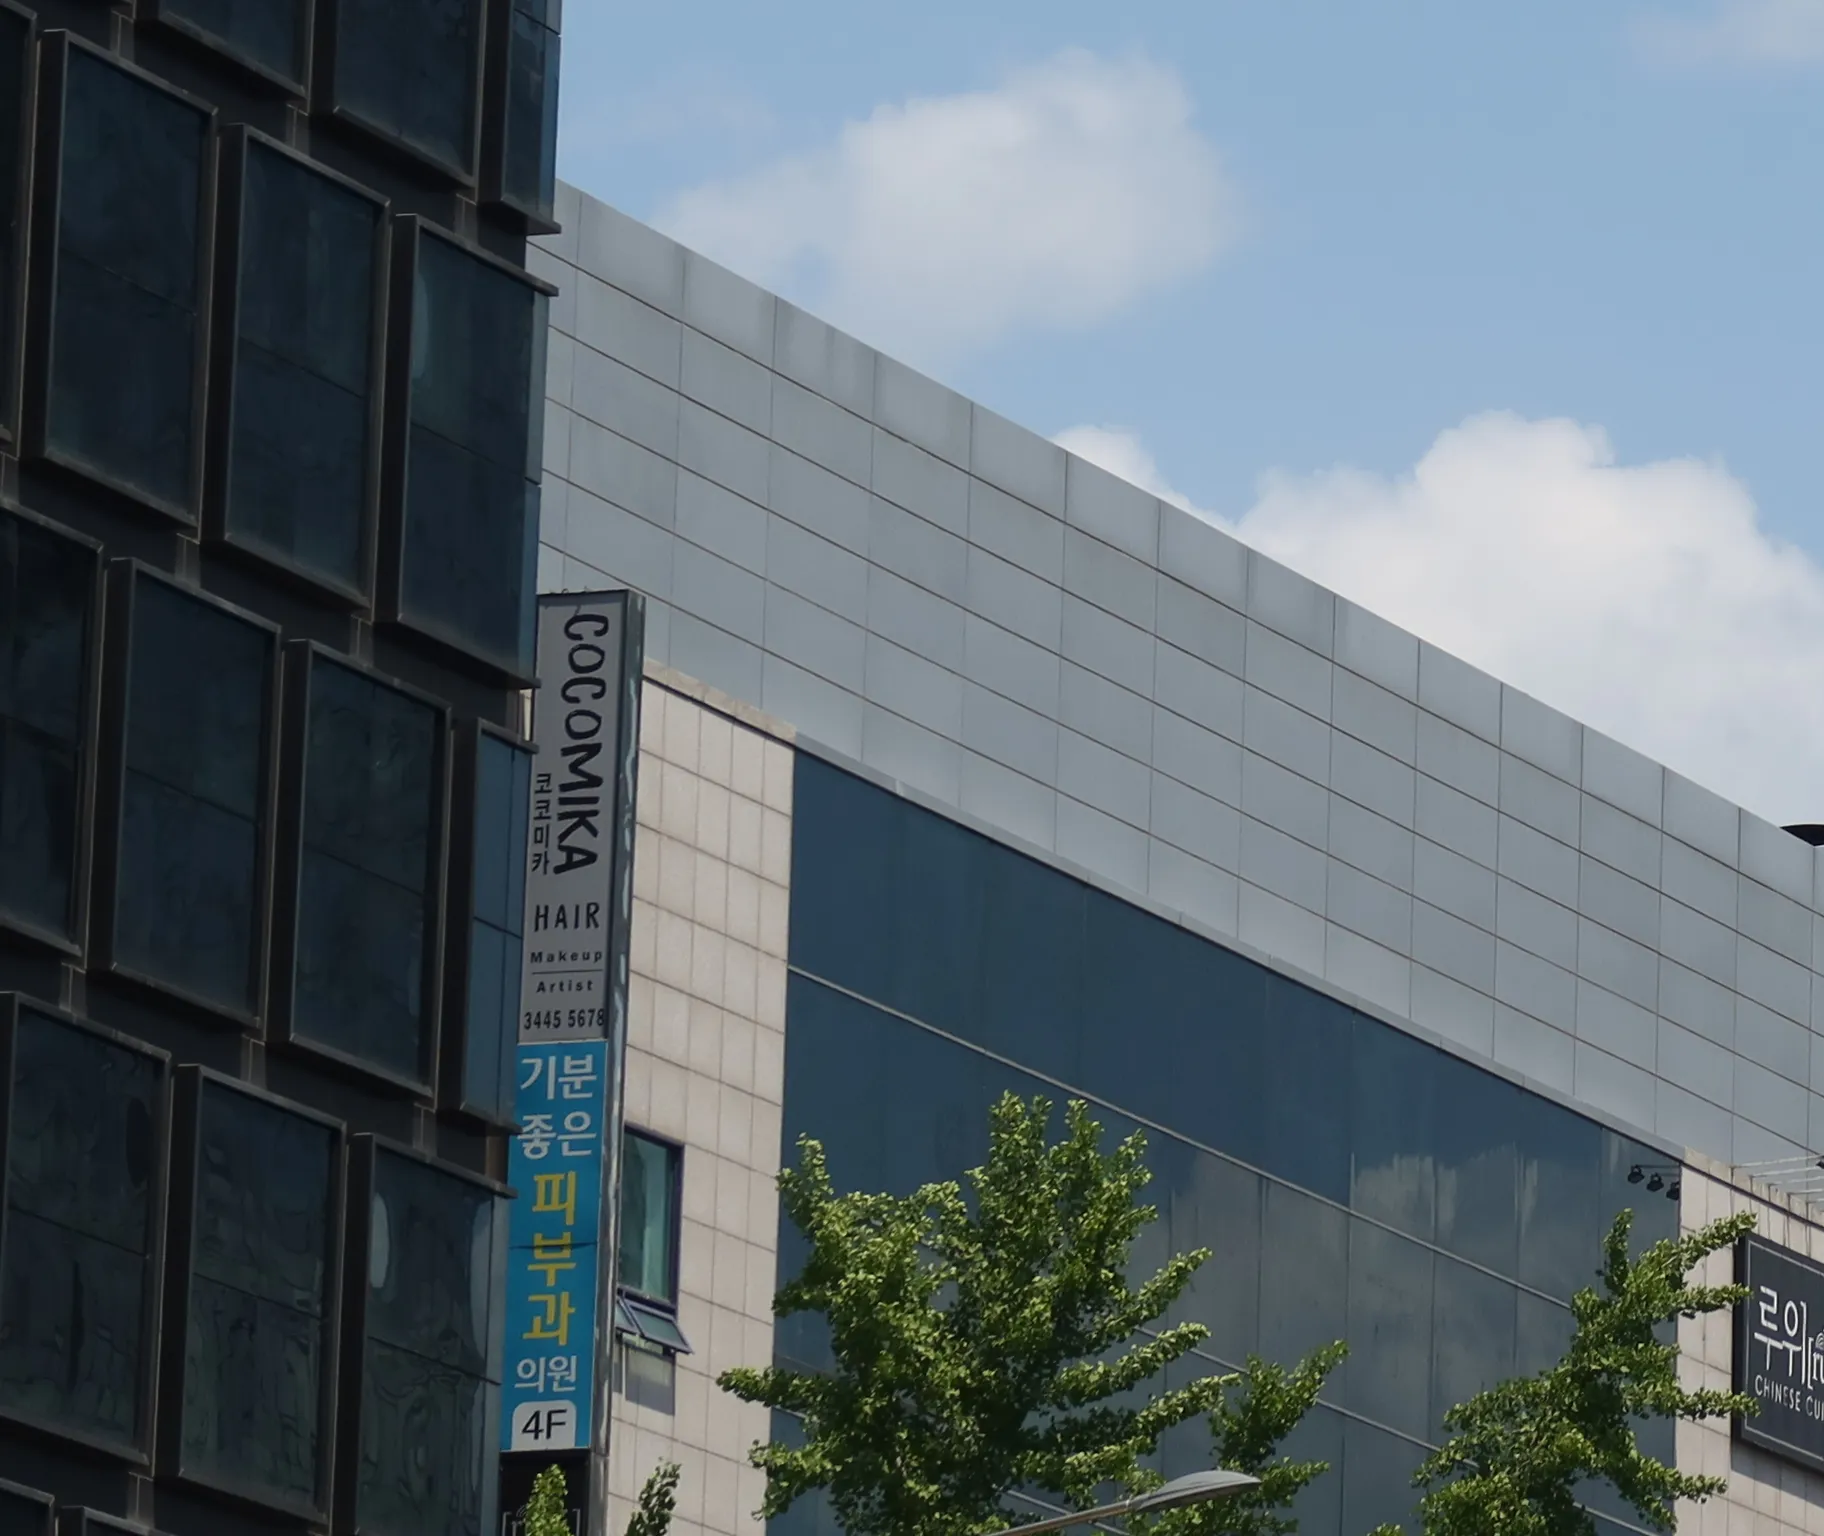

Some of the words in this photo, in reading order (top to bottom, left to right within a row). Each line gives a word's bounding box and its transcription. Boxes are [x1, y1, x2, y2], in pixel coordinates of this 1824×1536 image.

[553, 613, 609, 875] COCOMIKA
[531, 772, 553, 876] 코코미카
[533, 902, 600, 932] HAIR
[530, 950, 603, 964] Makeup
[536, 979, 594, 993] Artist
[523, 1010, 562, 1030] 3445
[567, 1008, 605, 1028] 5678
[520, 1054, 597, 1100] 기분
[517, 1111, 597, 1159] 좋은
[522, 1170, 577, 1346] 피부과
[514, 1355, 577, 1393] 의원
[1754, 1374, 1801, 1412] CHINESE
[521, 1409, 568, 1440] 4F
